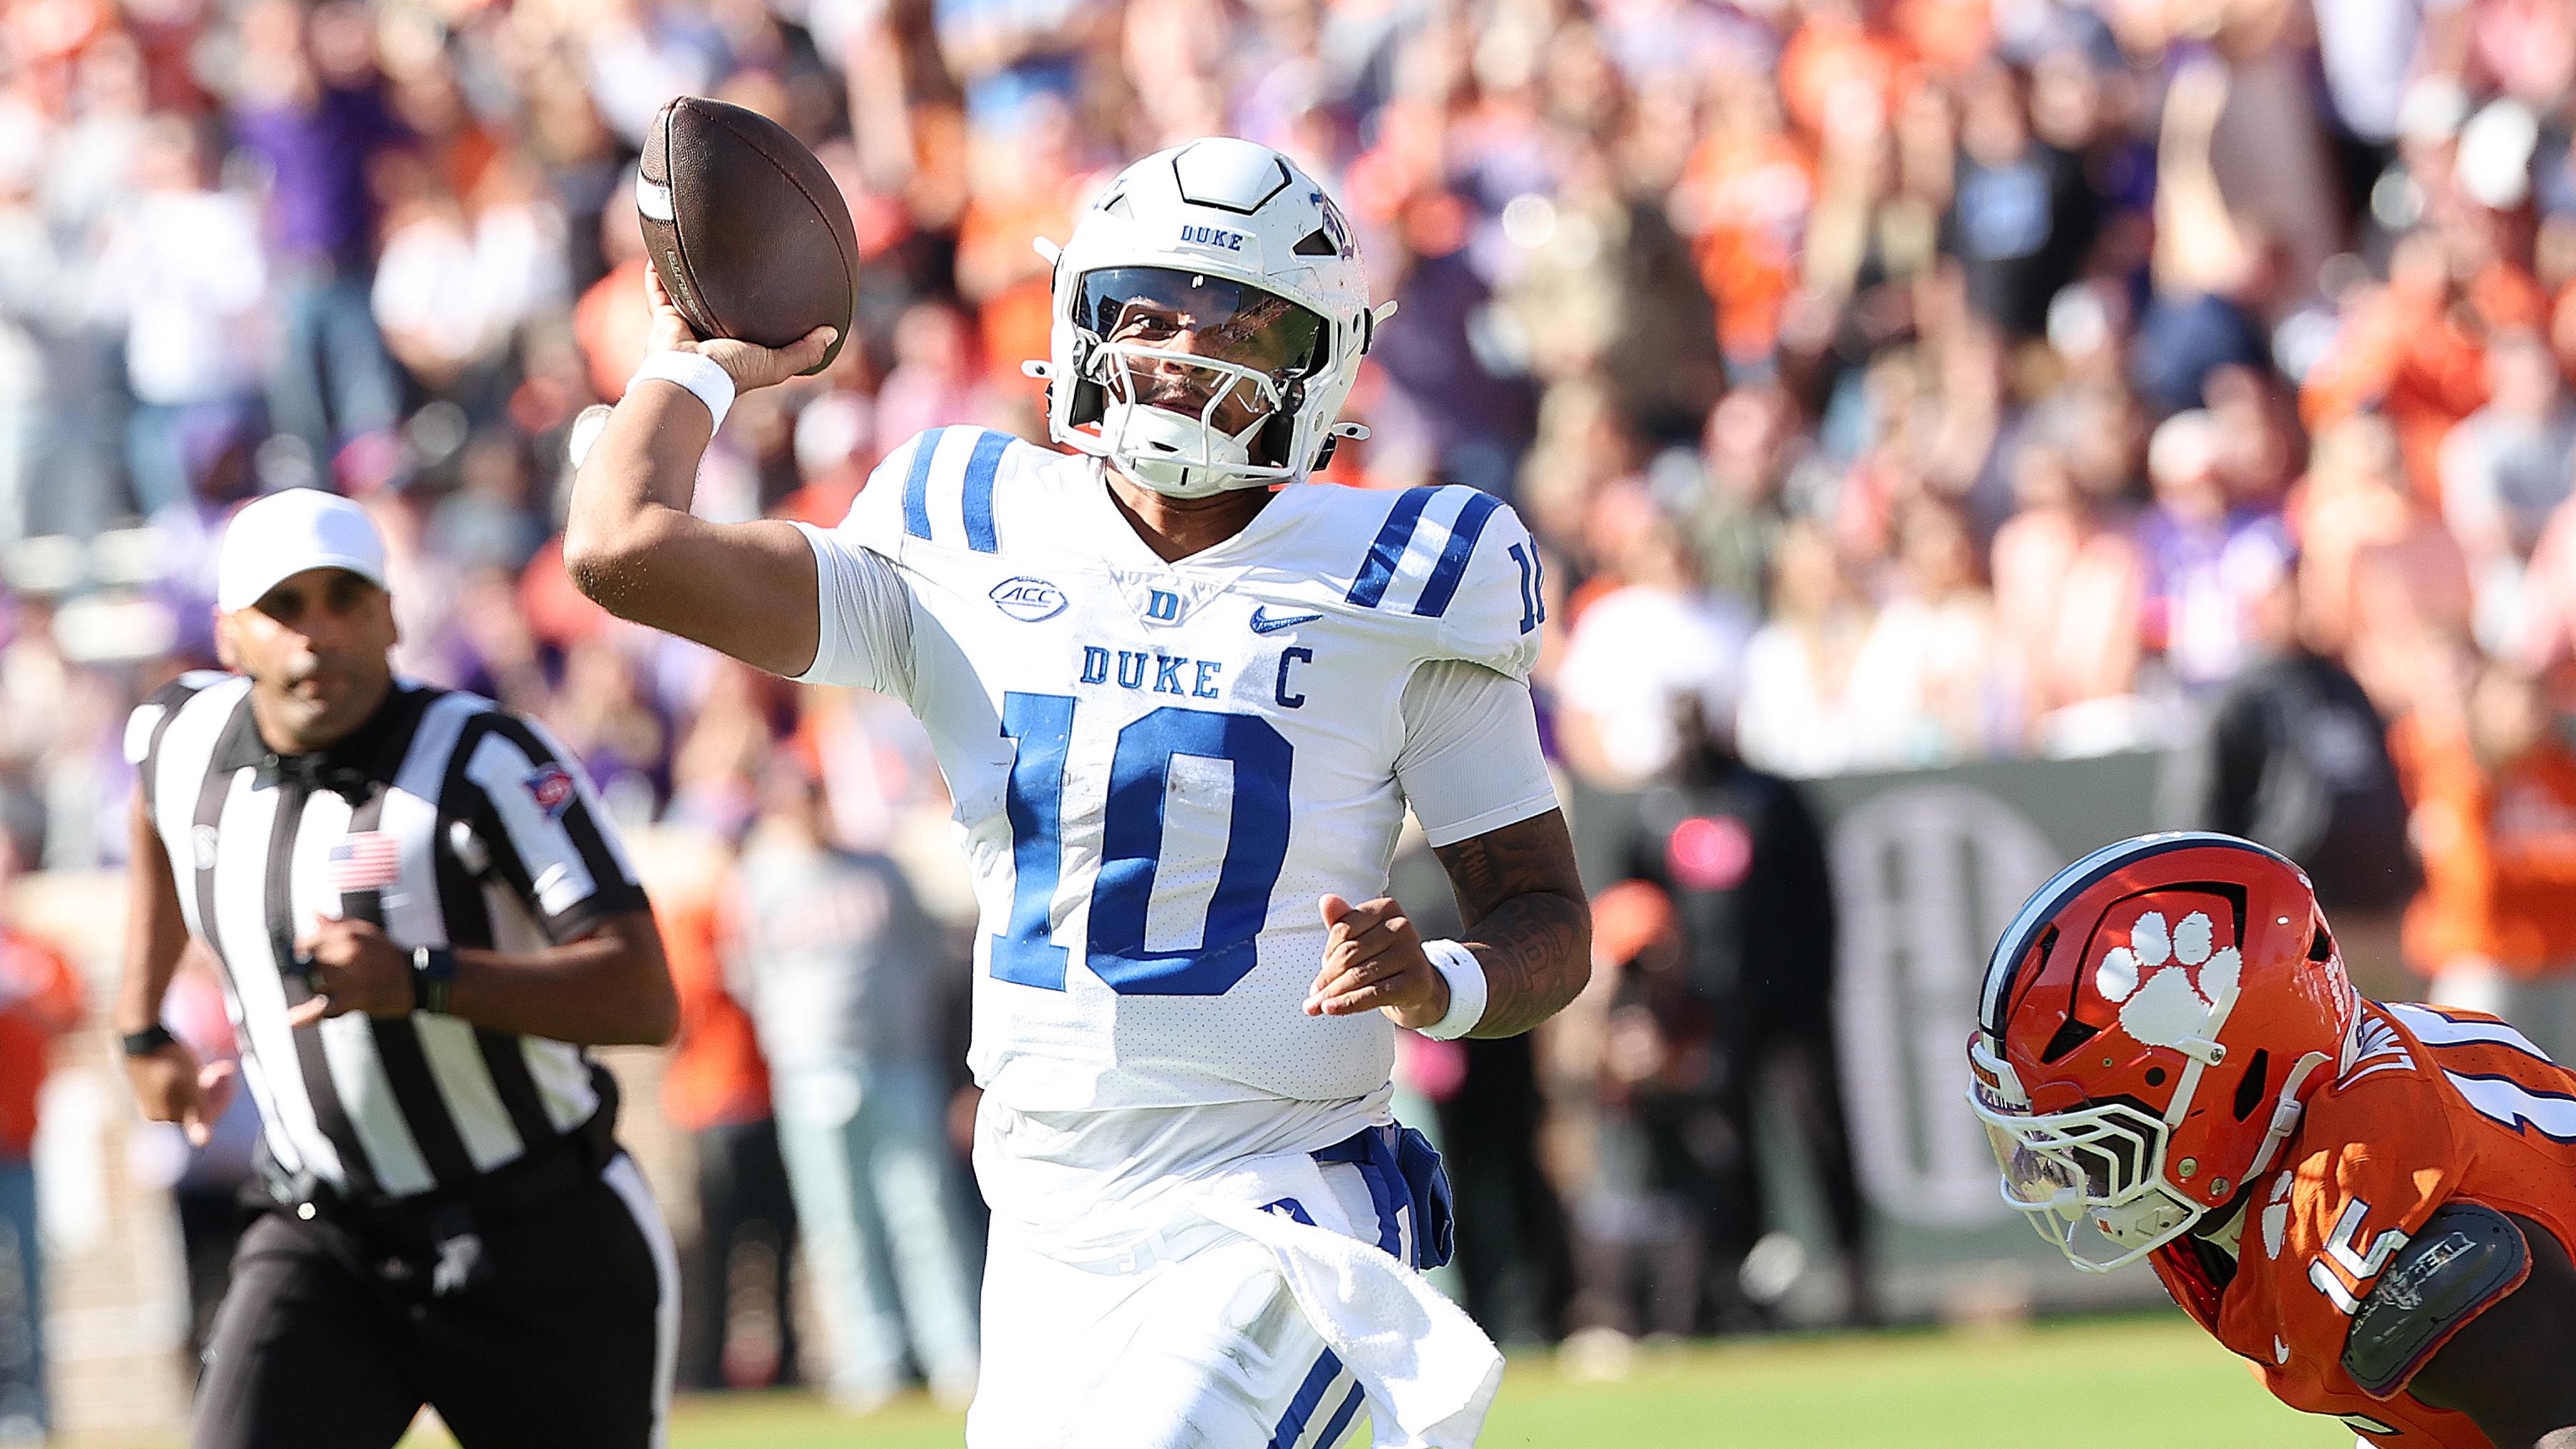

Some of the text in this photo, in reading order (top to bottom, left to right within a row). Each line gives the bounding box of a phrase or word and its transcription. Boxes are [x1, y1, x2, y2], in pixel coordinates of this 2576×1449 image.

[1181, 225, 1243, 251] DUKE
[1000, 587, 1055, 603] ACC
[1146, 589, 1179, 620] D
[1080, 645, 1221, 698] DUKE
[1275, 647, 1313, 708] C
[990, 691, 1294, 996] 10
